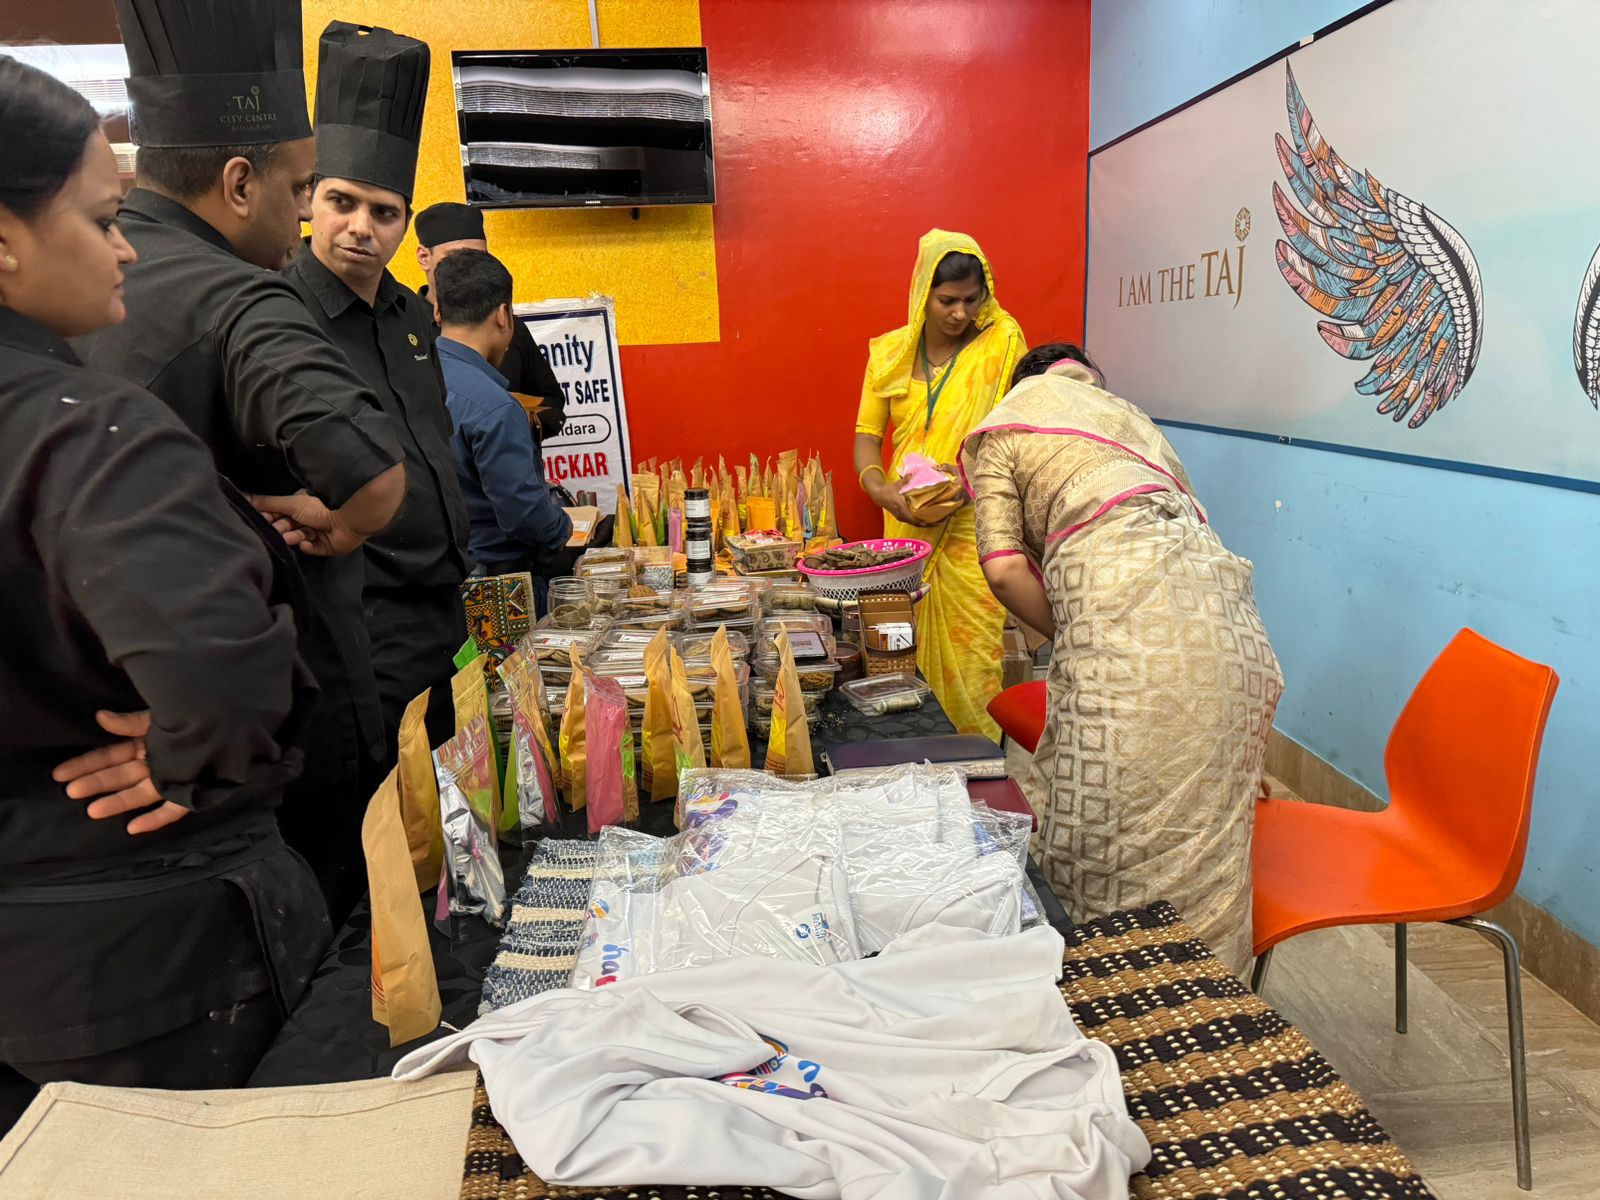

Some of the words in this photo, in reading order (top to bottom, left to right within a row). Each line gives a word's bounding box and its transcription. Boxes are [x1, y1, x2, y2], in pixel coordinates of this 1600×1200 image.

[232, 95, 260, 112] TAJ
[1118, 277, 1123, 307] I
[1127, 272, 1152, 307] AM
[1158, 264, 1196, 302] THE
[1201, 245, 1246, 310] TAJ
[575, 378, 610, 405] SAFE
[543, 452, 609, 481] ICKAR
